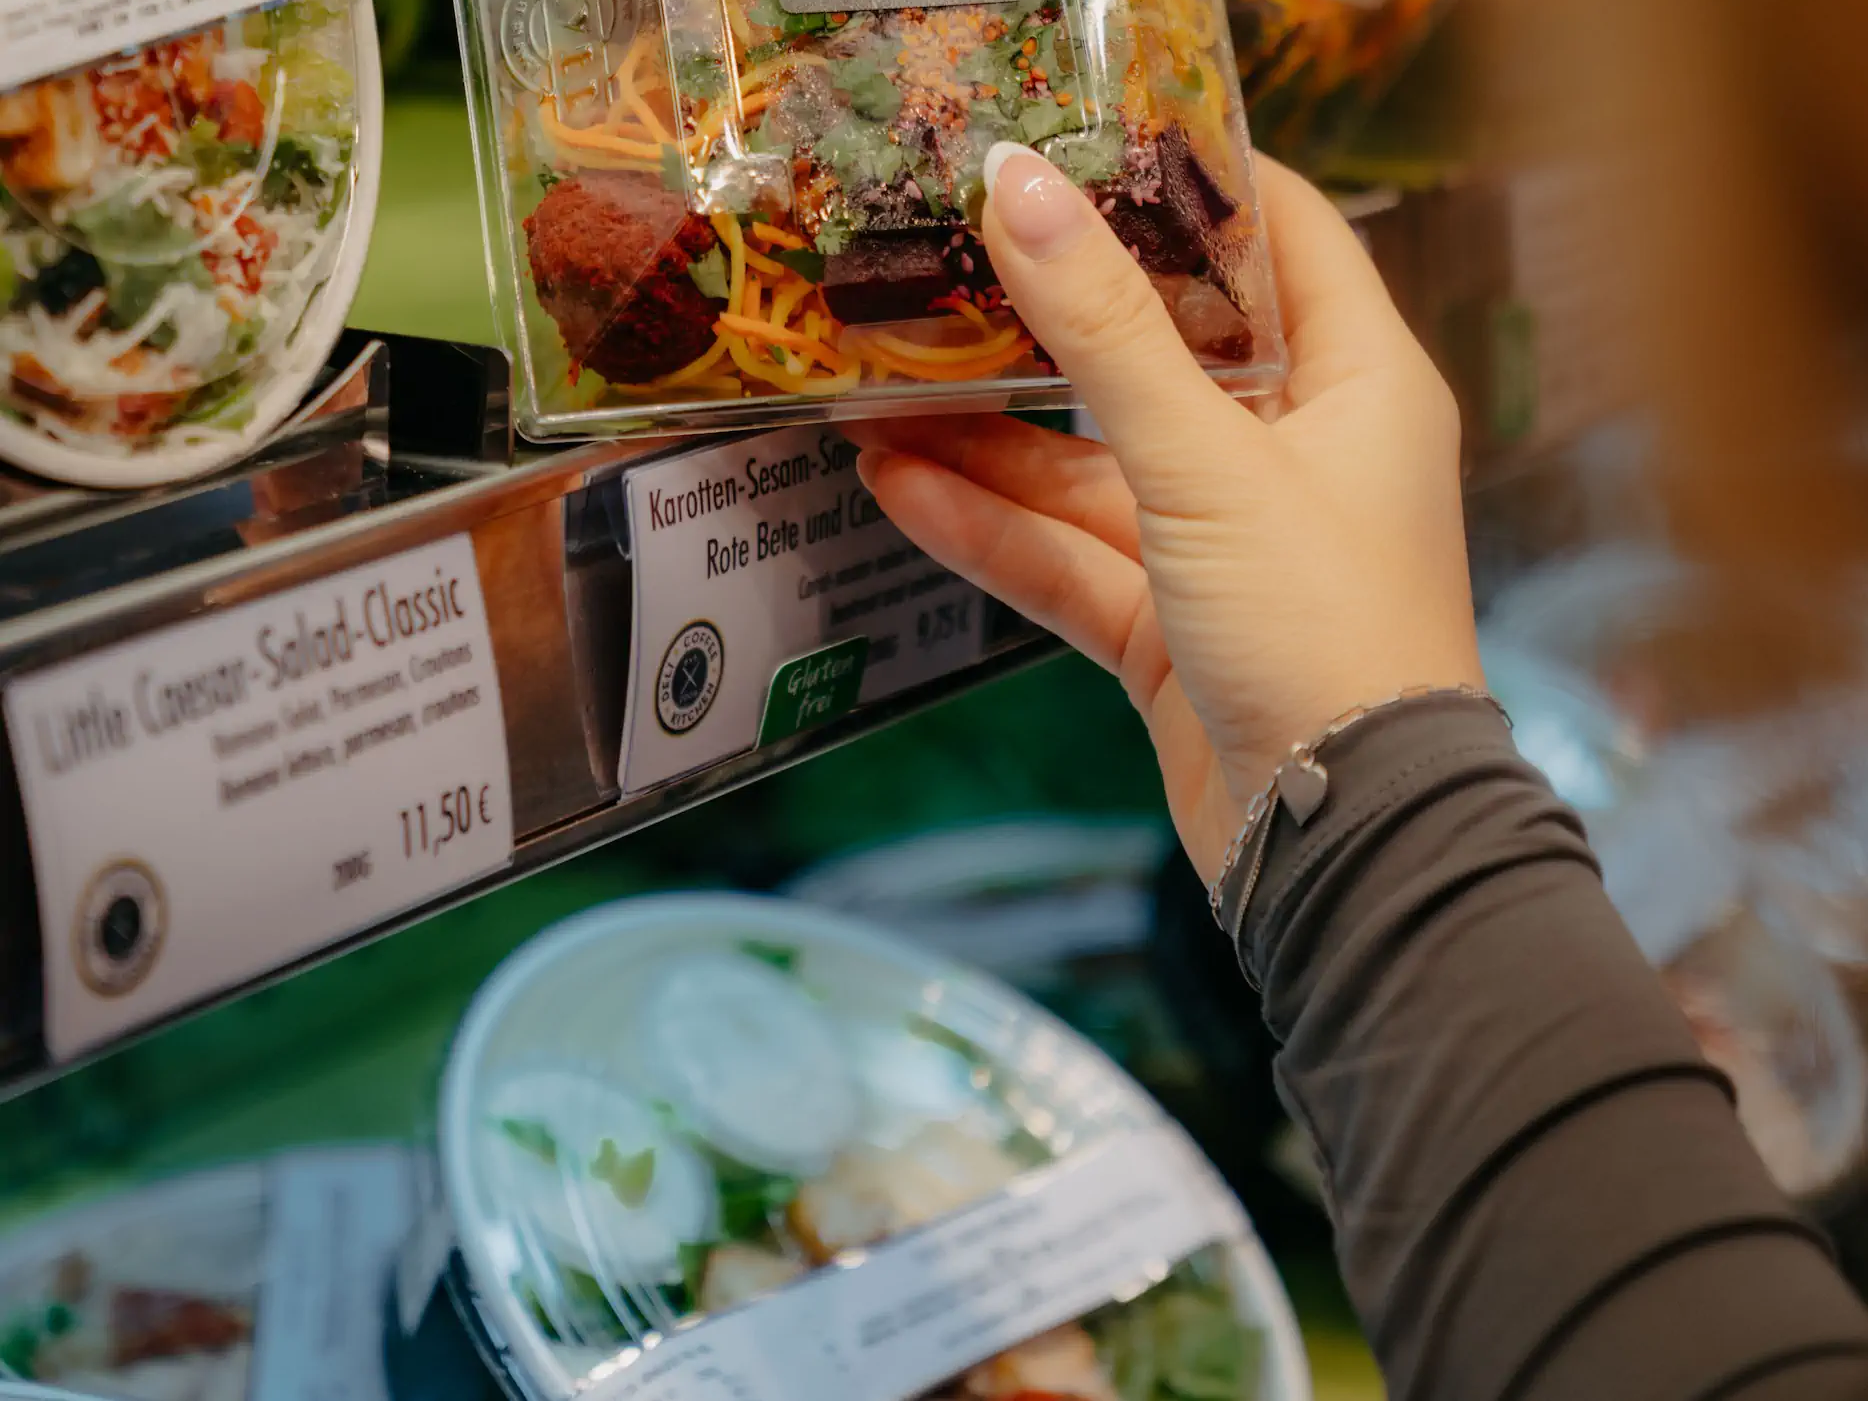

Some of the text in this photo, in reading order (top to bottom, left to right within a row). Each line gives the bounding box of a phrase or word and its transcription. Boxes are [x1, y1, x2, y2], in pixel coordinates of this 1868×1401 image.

[650, 431, 851, 532] Karotten-Sesam-Sa
[707, 535, 749, 580] Rote
[757, 518, 799, 562] Bete
[806, 493, 843, 545] und
[33, 682, 132, 776] Little
[132, 567, 466, 736] Caesar-Salad-Classic
[661, 661, 675, 702] DELI
[786, 652, 856, 697] Gluten
[670, 682, 714, 726] KITCHEN
[795, 686, 835, 730] frei
[398, 785, 471, 860] 11,50
[479, 782, 492, 824] €
